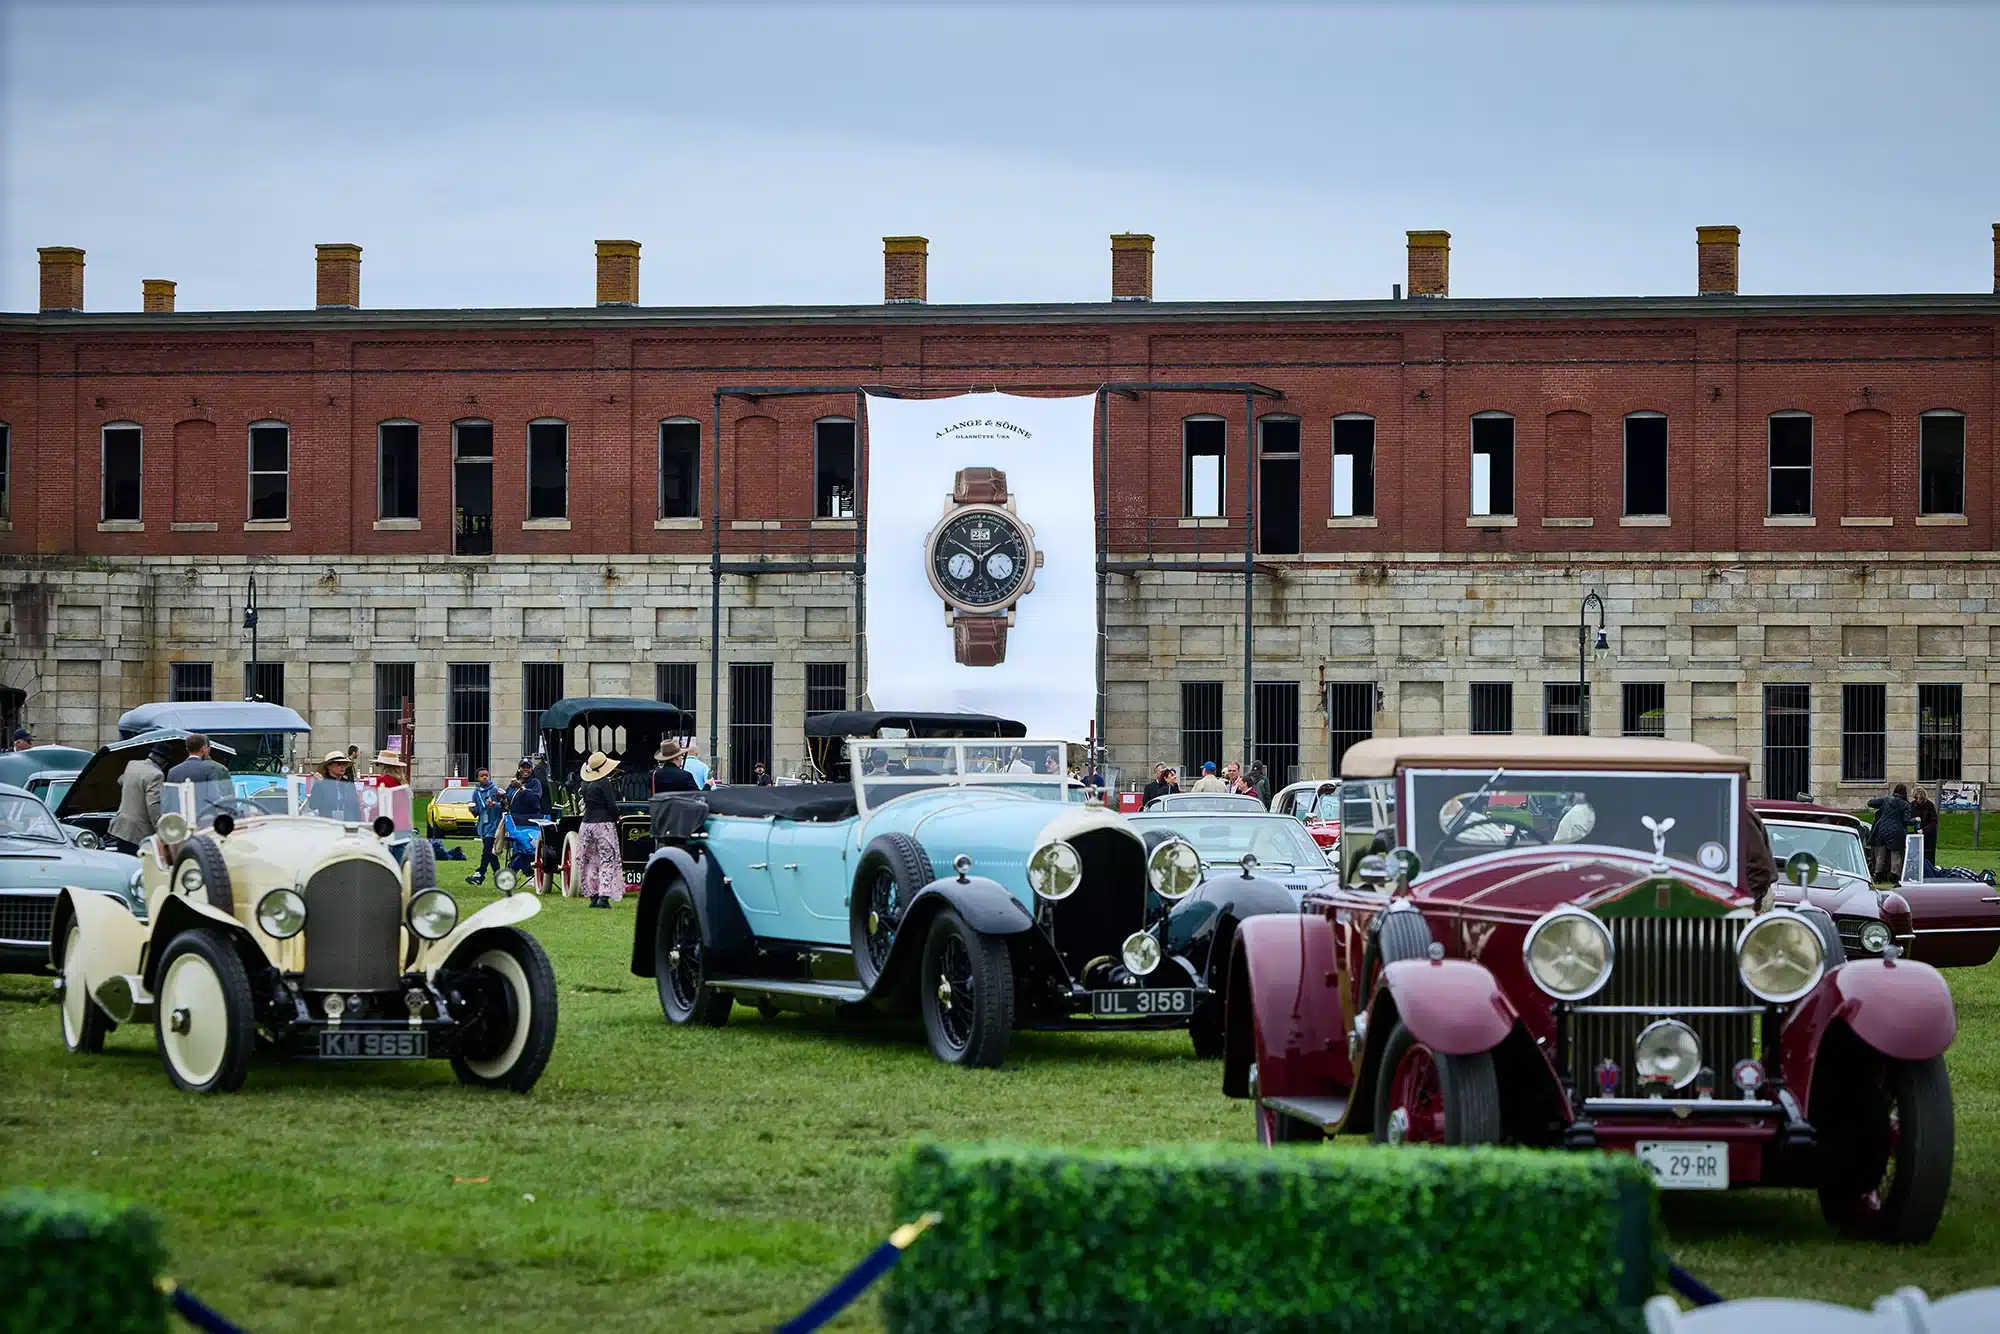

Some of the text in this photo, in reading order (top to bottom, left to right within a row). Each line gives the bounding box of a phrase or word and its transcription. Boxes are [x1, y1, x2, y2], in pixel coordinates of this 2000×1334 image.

[984, 419, 993, 427] &
[995, 420, 1033, 440] SÖHNE
[972, 529, 989, 539] 25
[626, 872, 646, 884] C19
[1100, 991, 1185, 1012] UL 3158
[326, 1034, 423, 1055] KM 9651
[1670, 1155, 1717, 1177] 29-RR
